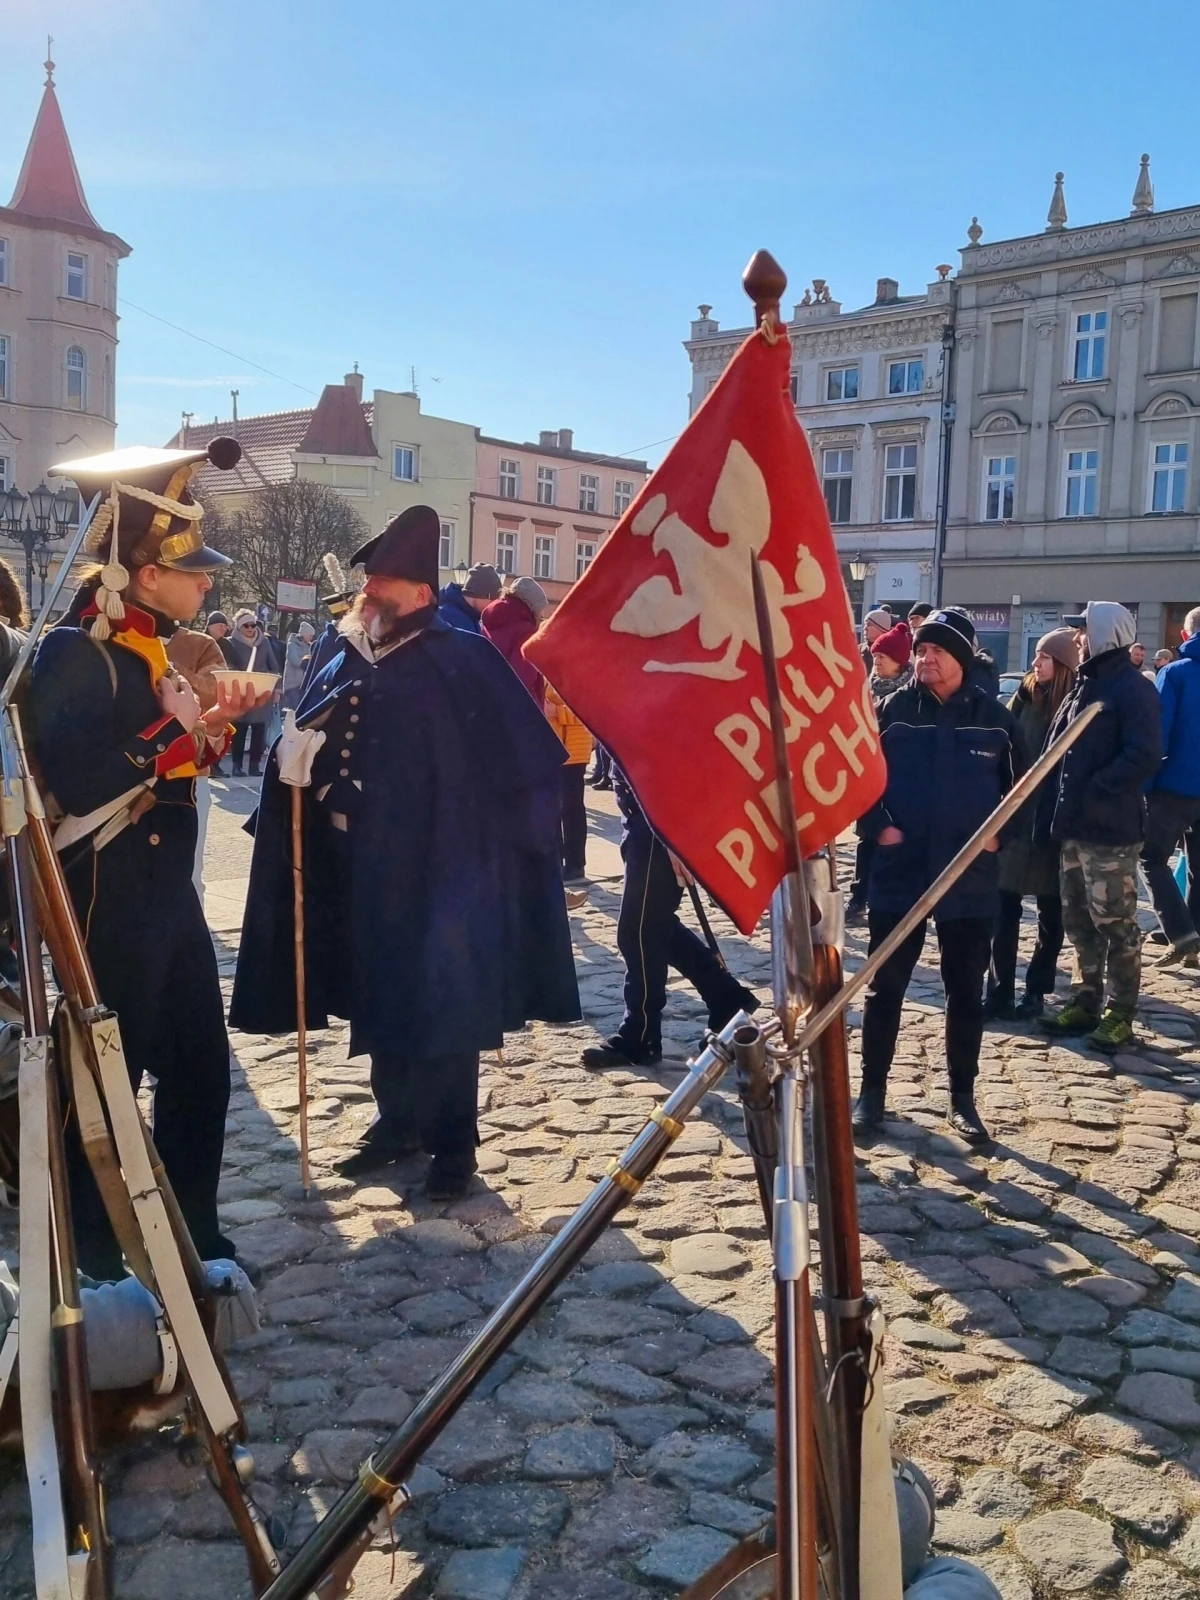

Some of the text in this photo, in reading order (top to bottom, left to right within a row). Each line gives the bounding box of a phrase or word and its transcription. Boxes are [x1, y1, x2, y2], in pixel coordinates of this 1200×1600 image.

[891, 577, 903, 588] 20
[966, 610, 1007, 624] Kwiaty
[714, 621, 853, 782] PUŁK
